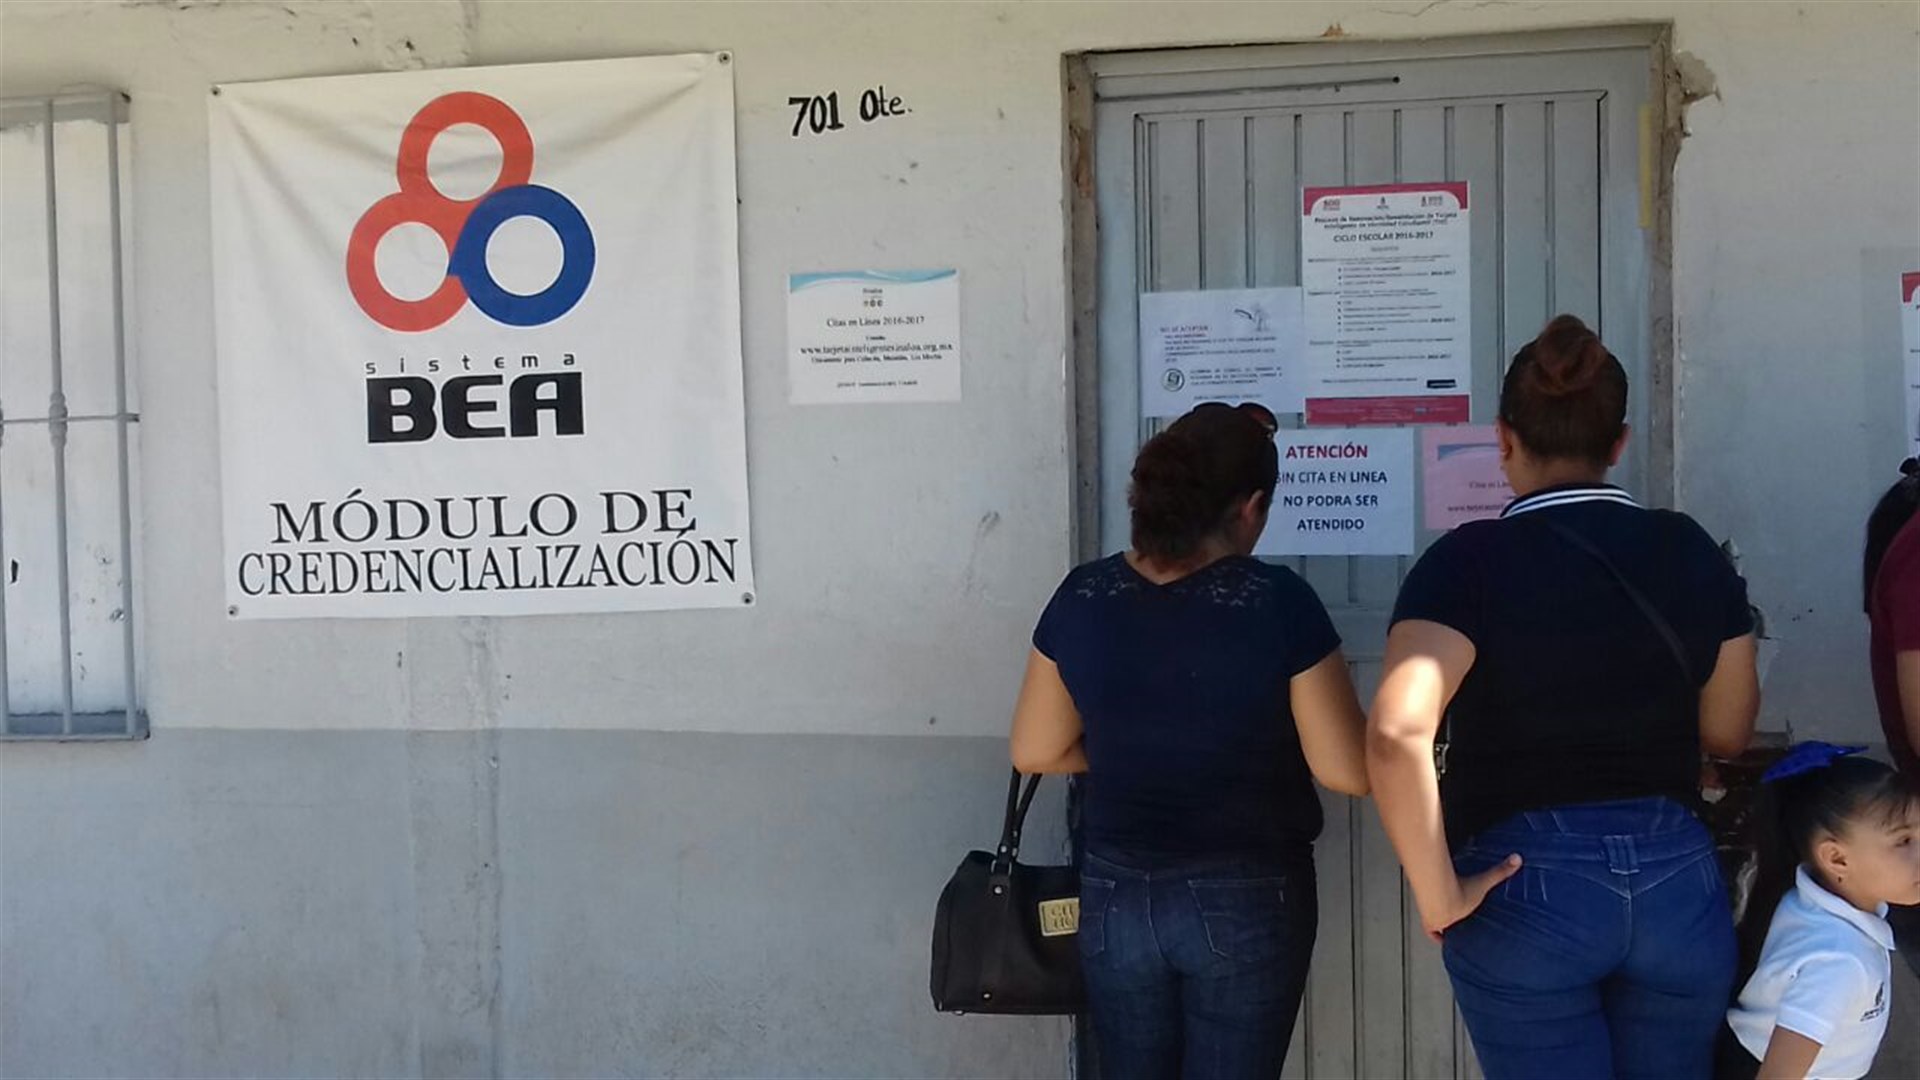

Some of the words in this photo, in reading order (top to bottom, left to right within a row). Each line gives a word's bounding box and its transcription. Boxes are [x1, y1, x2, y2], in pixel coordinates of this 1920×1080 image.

[788, 90, 845, 137] 701
[860, 85, 913, 122] Ote.
[1333, 234, 1358, 243] CICLO
[1358, 232, 1394, 242] ESCOLAR
[1394, 230, 1434, 241] 2016-2017
[827, 317, 847, 327] Citas
[848, 319, 858, 327] en
[882, 315, 925, 326] 2016-2017
[366, 353, 576, 375] sistema
[366, 372, 585, 444] BEA
[1285, 441, 1368, 459] ATENCIÓN
[1298, 472, 1327, 484] CITA
[1330, 471, 1347, 484] EN
[1351, 471, 1388, 484] LINEA
[1283, 495, 1303, 507] NO
[1306, 495, 1351, 507] PODRA
[1355, 494, 1379, 507] SER
[270, 488, 577, 544] MÓDULO
[600, 488, 697, 534] DE
[1296, 518, 1365, 531] ATENDIDO
[239, 528, 738, 596] CREDENCIALIZACIÓN
